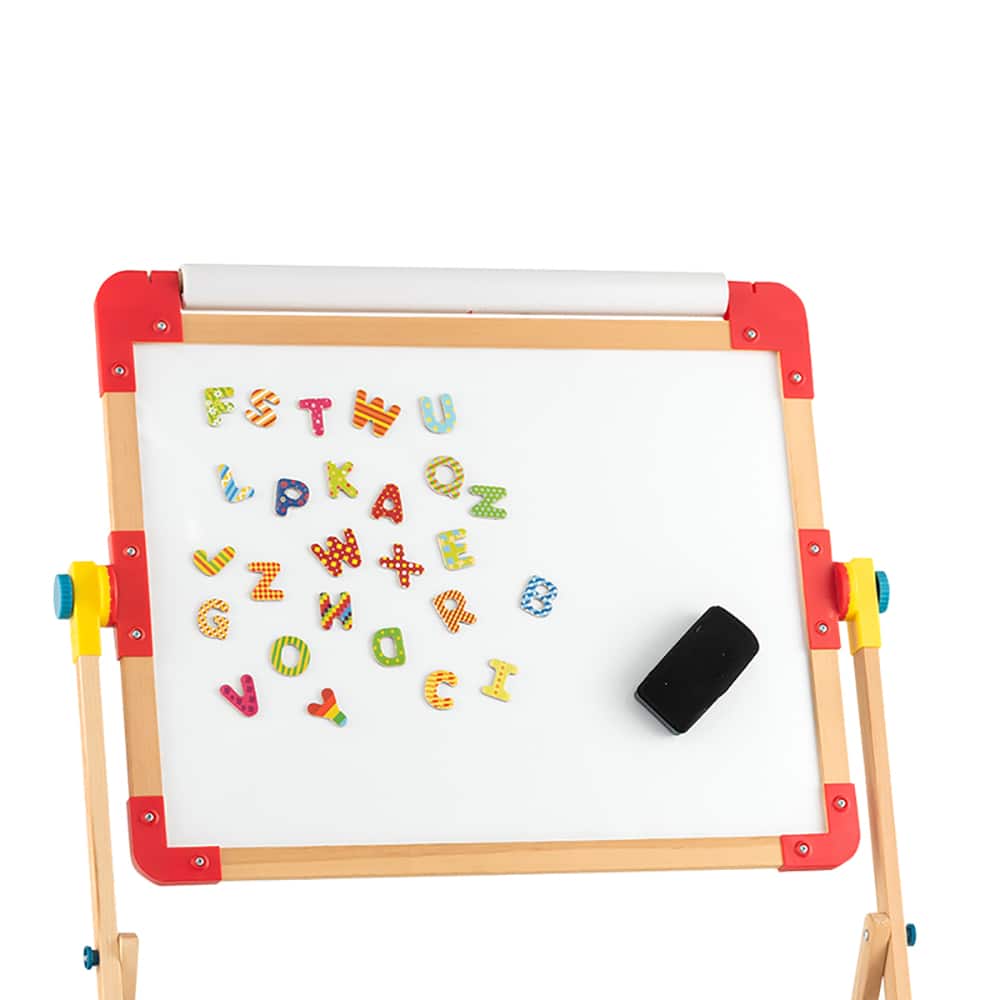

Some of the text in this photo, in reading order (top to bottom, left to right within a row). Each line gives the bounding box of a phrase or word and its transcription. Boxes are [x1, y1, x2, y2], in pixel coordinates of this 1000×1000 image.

[203, 386, 235, 427] F
[245, 388, 281, 428] S
[298, 397, 333, 437] T
[418, 392, 457, 433] U
[275, 477, 310, 516] P
[325, 460, 360, 499] K
[370, 483, 404, 524] A
[425, 455, 465, 500] Q
[247, 561, 286, 602] Z
[378, 543, 425, 589] X
[437, 527, 477, 571] E
[197, 598, 231, 640] G
[432, 589, 478, 634] R
[519, 574, 559, 618] B
[269, 635, 311, 677] O
[218, 657, 520, 728] V Y C I
